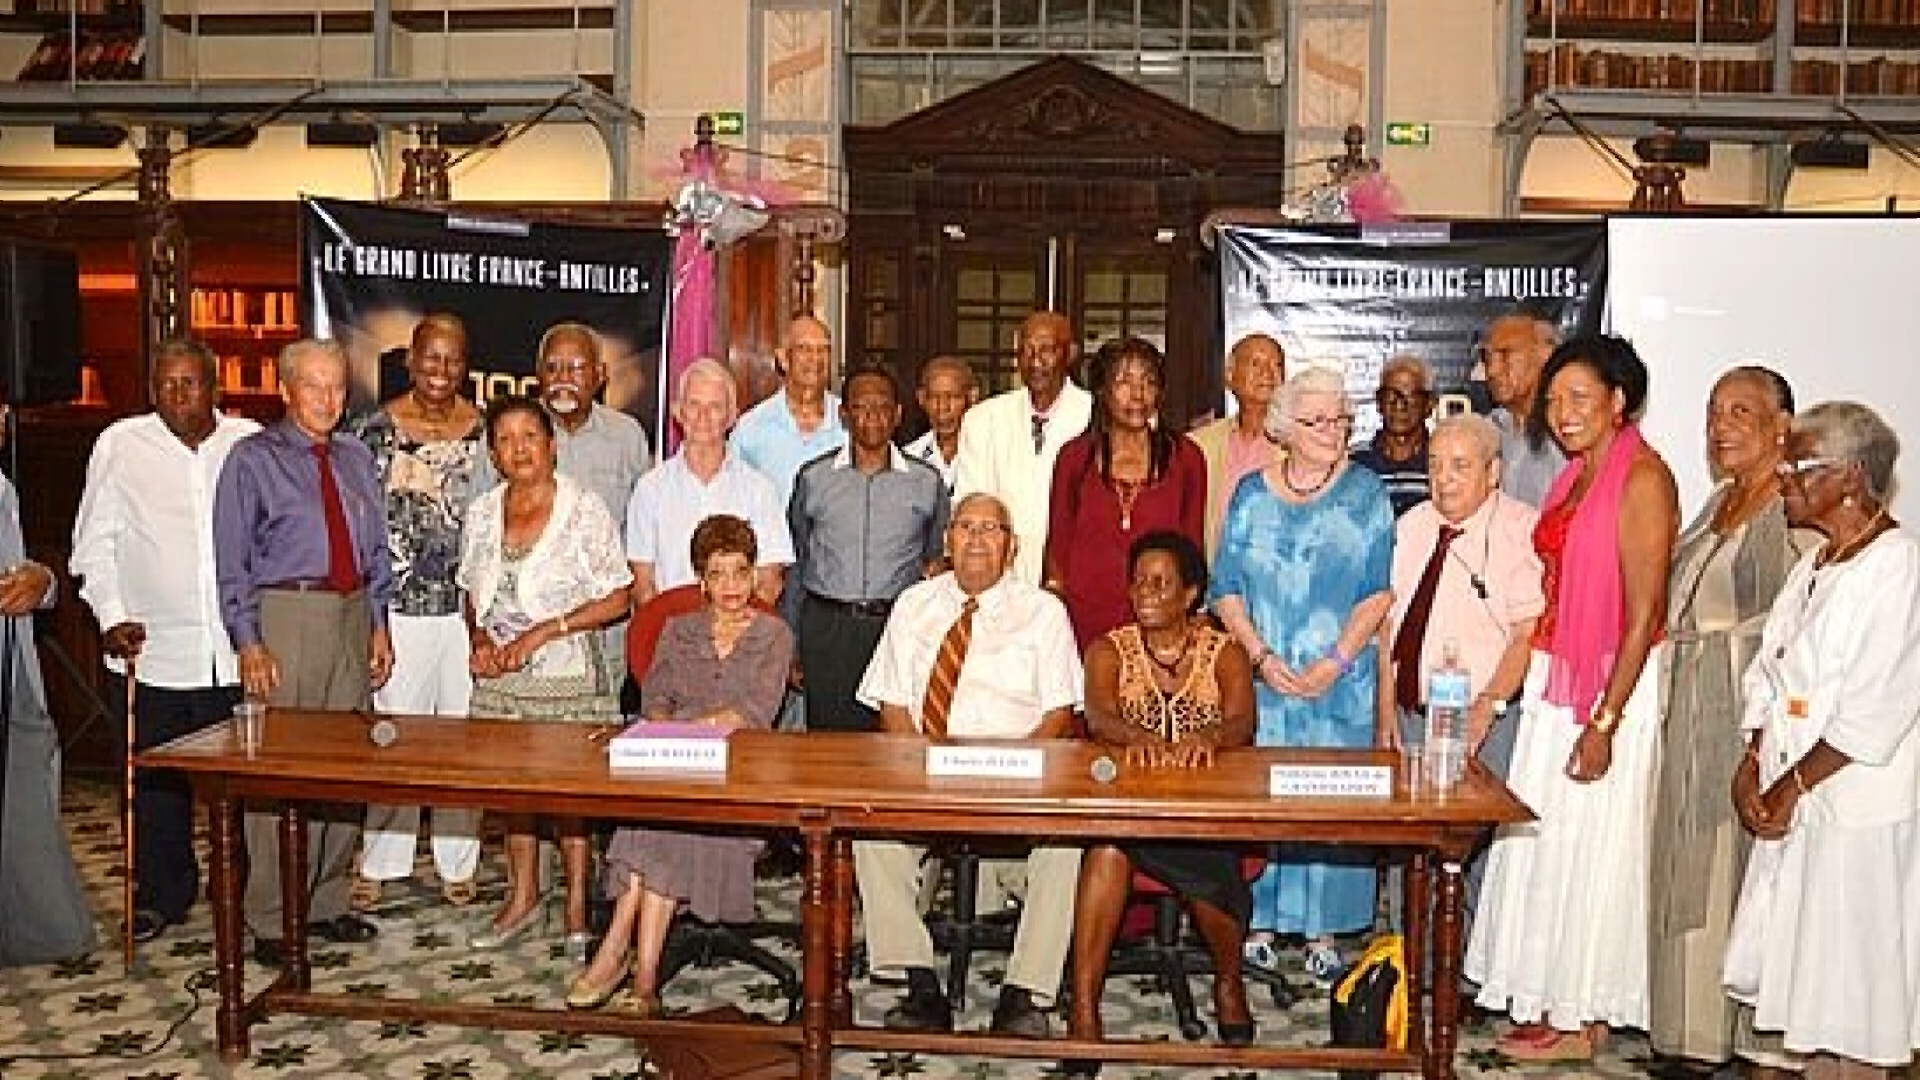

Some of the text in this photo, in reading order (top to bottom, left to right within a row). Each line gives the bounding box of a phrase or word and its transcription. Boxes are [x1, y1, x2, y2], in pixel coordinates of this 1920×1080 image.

[325, 242, 347, 275] LE
[355, 246, 417, 277] GRAND
[422, 250, 473, 284] LIVRE
